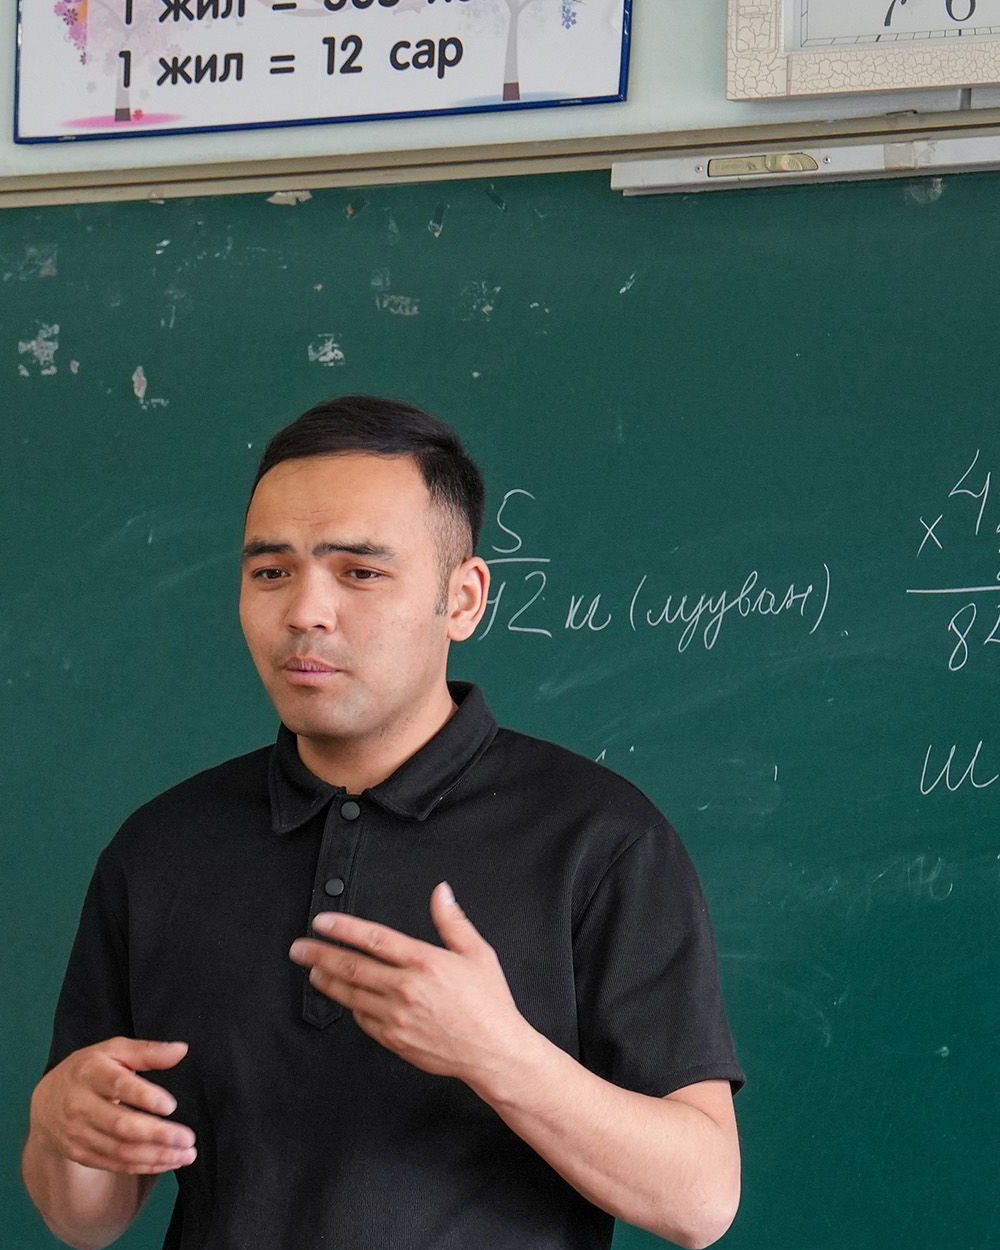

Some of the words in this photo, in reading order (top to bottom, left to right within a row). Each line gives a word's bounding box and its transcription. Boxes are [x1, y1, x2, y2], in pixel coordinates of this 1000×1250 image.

[118, 50, 132, 89] 1
[156, 52, 244, 87] жил
[321, 34, 363, 76] 12
[389, 36, 464, 80] сар
